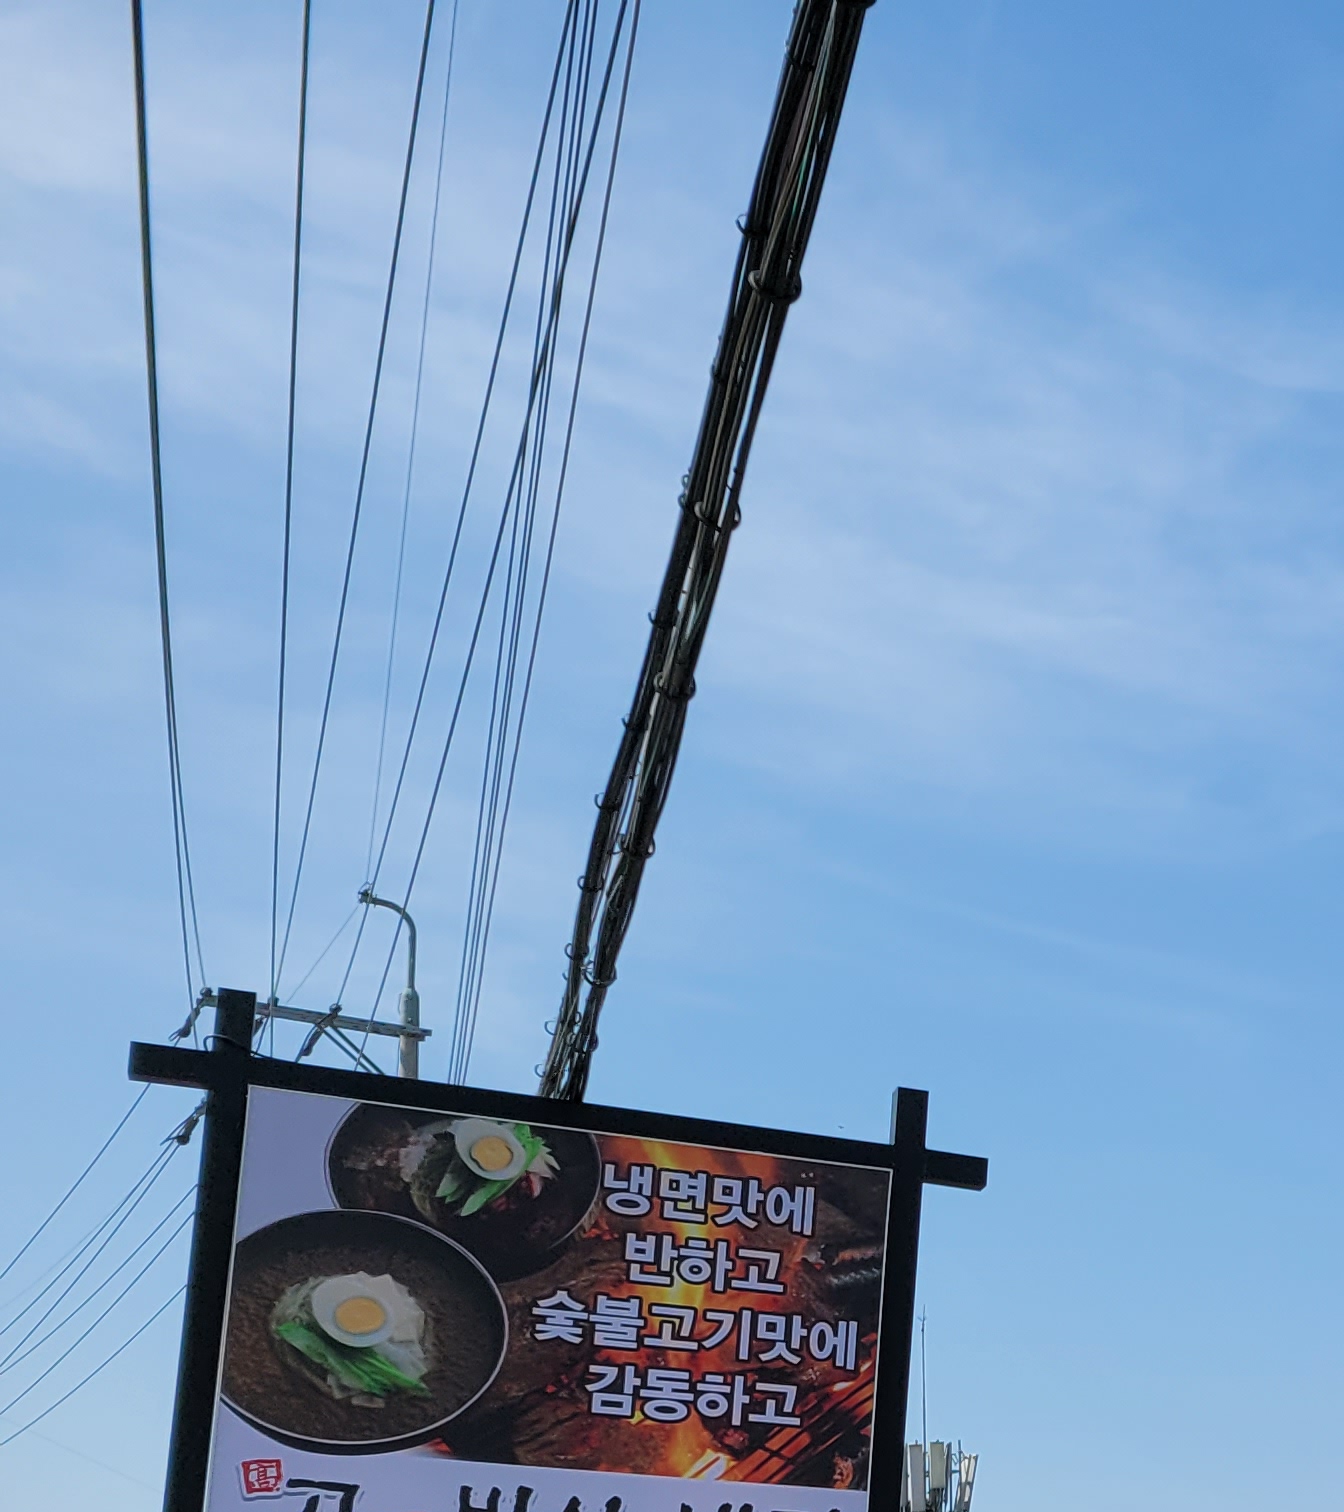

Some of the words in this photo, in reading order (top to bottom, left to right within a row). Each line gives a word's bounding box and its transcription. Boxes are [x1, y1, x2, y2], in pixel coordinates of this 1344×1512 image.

[603, 1163, 816, 1237] 냉면맛에
[624, 1232, 785, 1294] 반하고
[531, 1290, 859, 1371] 숯불고기맛에
[584, 1364, 801, 1427] 감동하고
